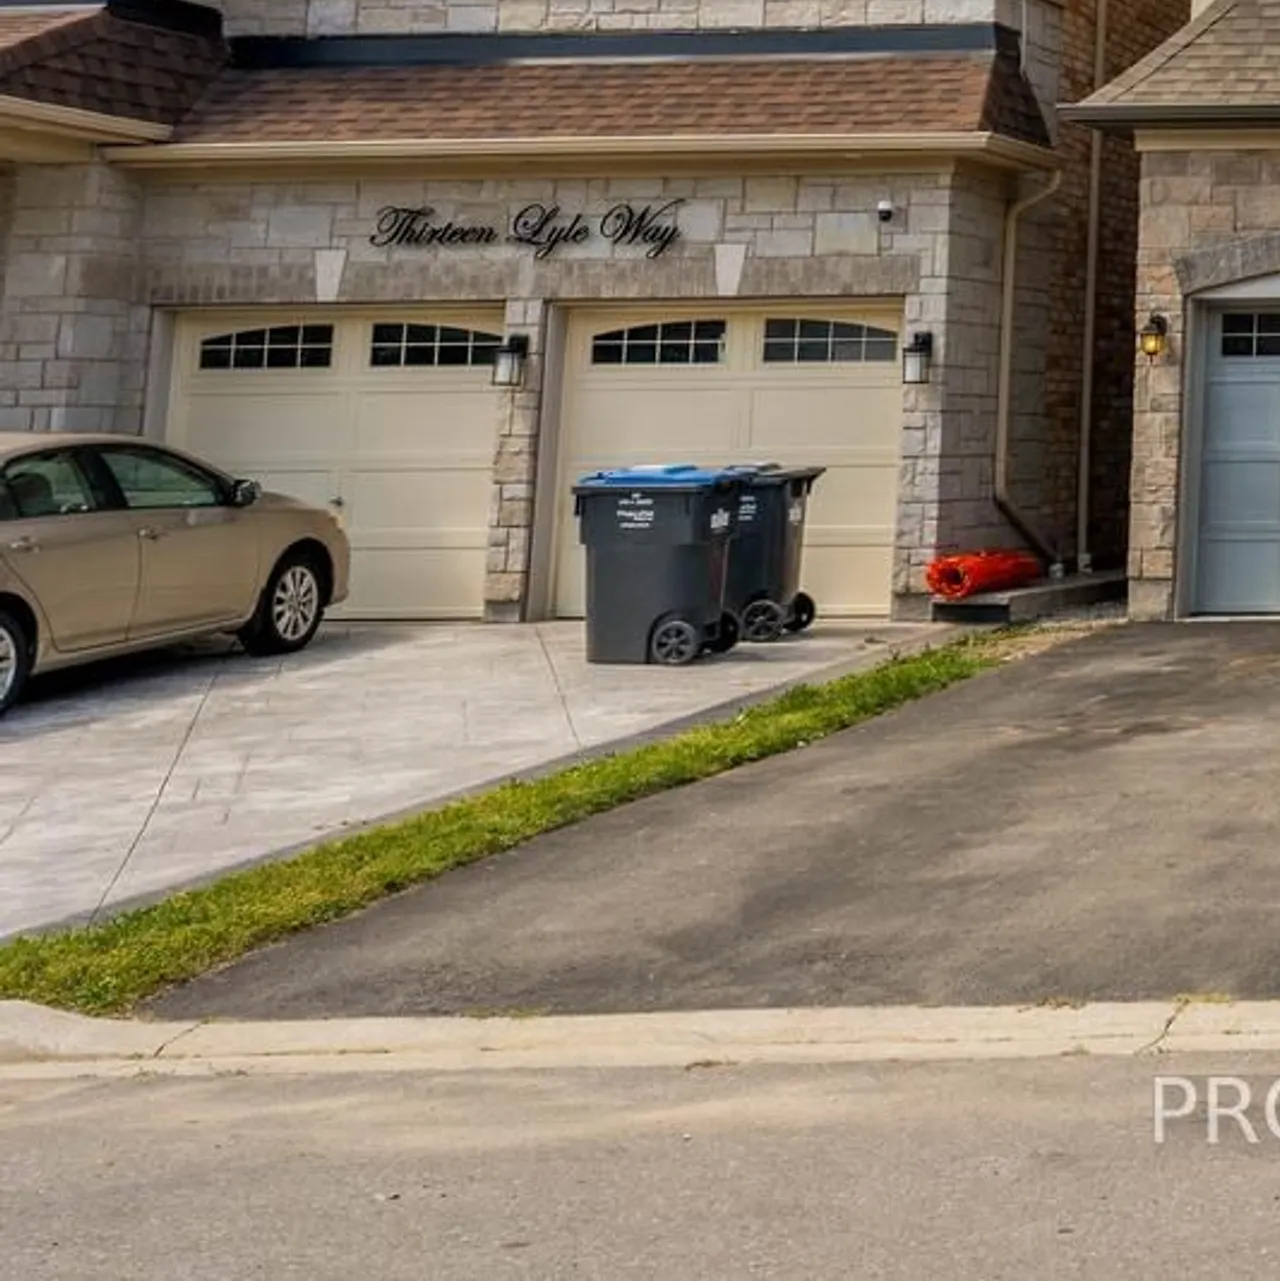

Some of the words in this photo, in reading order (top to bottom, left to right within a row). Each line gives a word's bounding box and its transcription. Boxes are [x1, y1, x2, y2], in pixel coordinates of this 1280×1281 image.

[369, 205, 498, 247] Thirteen
[505, 202, 590, 259] Lyle
[599, 198, 686, 259] Way
